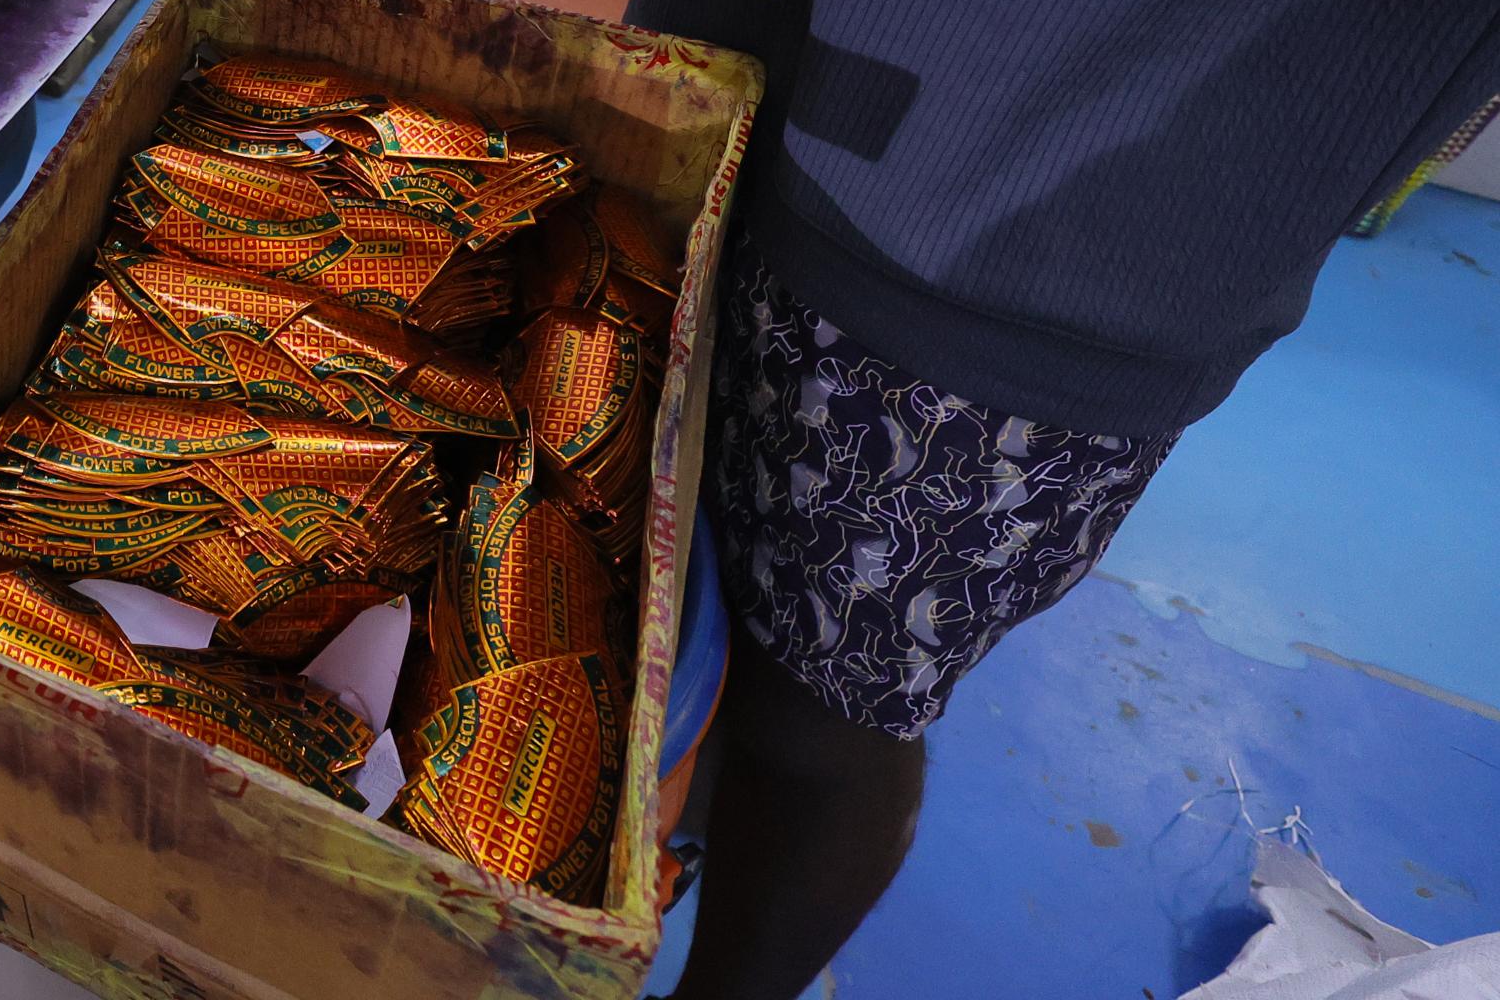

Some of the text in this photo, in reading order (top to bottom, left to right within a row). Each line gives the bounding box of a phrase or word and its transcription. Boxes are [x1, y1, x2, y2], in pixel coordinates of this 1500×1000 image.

[256, 70, 326, 85] MERCURY
[203, 83, 255, 114] FLOWER
[262, 104, 300, 119] POTS
[176, 117, 231, 147] FLOWER
[204, 160, 276, 190] MERCURY
[147, 164, 201, 218] FLOWER
[205, 210, 248, 232] POTS
[257, 217, 327, 237] SPECIAL
[275, 250, 340, 281] SPECIAL
[189, 276, 270, 294] MERCURY
[202, 317, 260, 337] SPECIAL
[77, 360, 147, 396] FLOWER
[123, 354, 196, 381] FLOWER
[555, 332, 577, 395] MERCURY
[259, 381, 319, 412] SPECIAL
[573, 353, 637, 448] FLOWER POTS
[46, 398, 254, 453] FLOWER POTS SPECIAL
[421, 402, 498, 434] SPECIAL
[58, 452, 136, 472] FLOWER
[275, 486, 339, 508] SPECIAL
[487, 498, 530, 559] FLOWER
[52, 557, 101, 573] POTS
[481, 567, 497, 614] POTS
[550, 559, 567, 647] MERCURY
[175, 693, 229, 716] POTS
[440, 698, 476, 766] SPECIAL
[595, 679, 619, 773] SPECIAL
[510, 715, 550, 810] MERCURY
[587, 782, 614, 838] POTS
